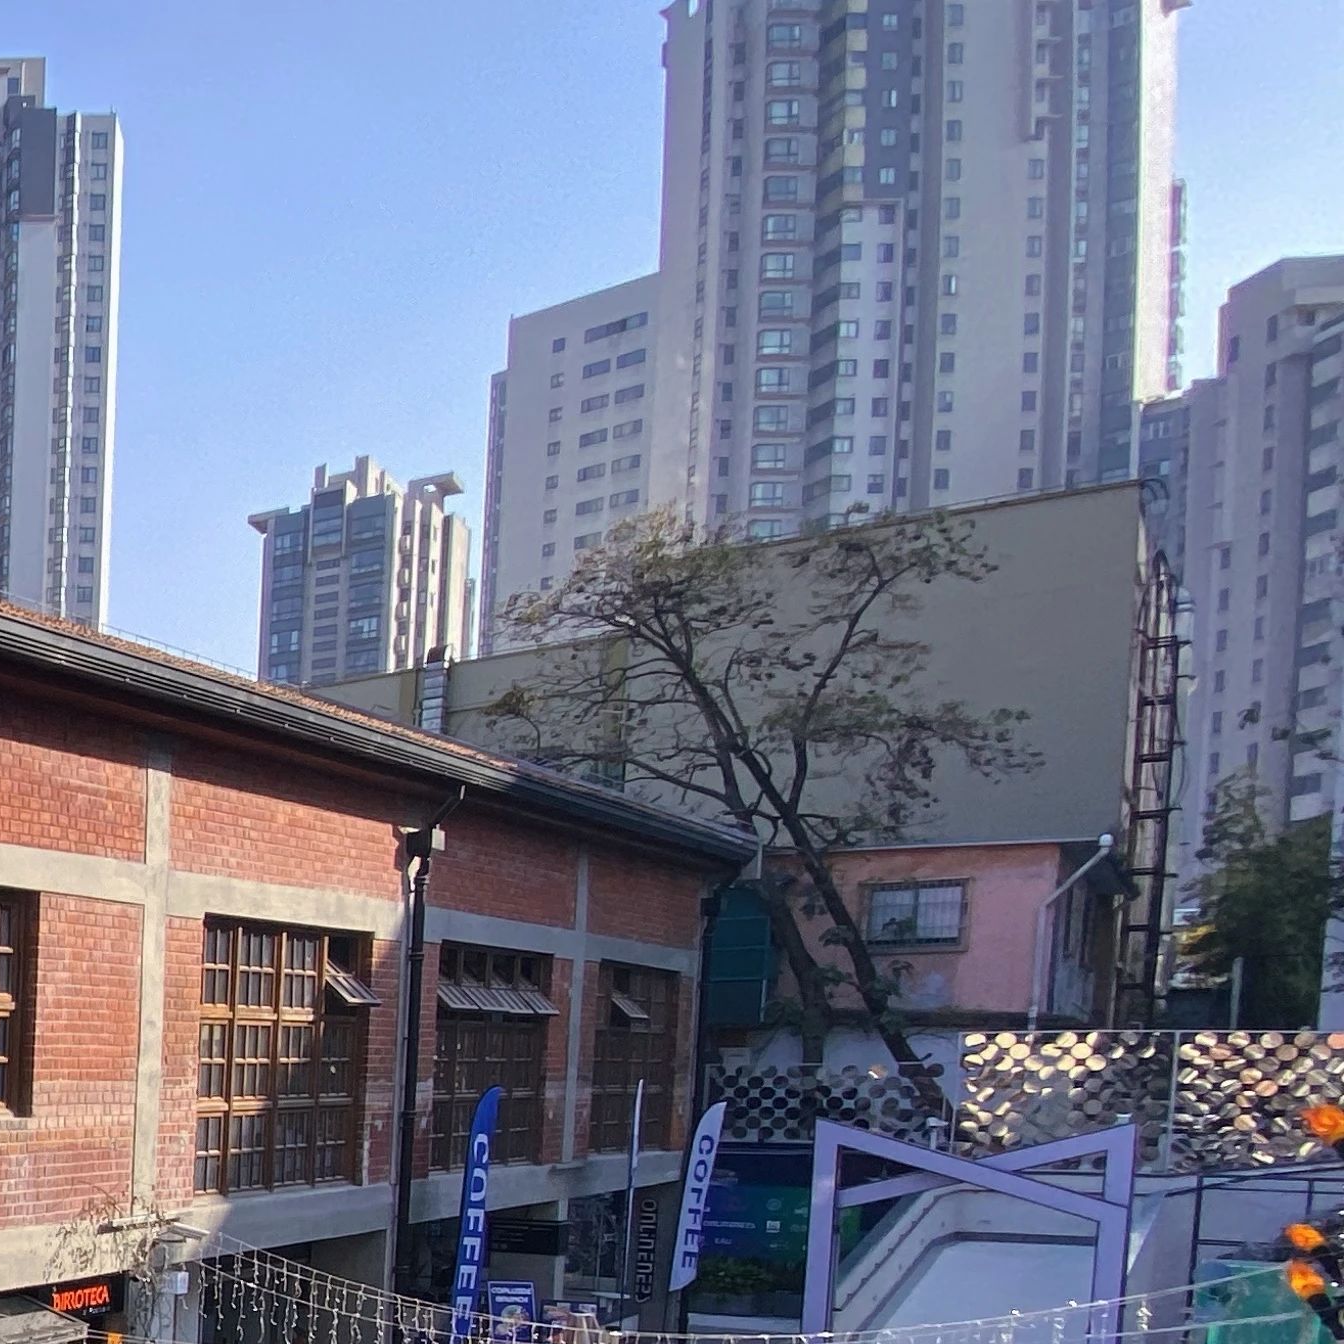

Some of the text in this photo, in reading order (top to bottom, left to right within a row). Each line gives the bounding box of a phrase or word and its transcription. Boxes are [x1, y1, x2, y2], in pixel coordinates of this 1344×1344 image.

[455, 1132, 490, 1321] COFFEE
[682, 1134, 715, 1270] COFFEE
[51, 1283, 111, 1311] BIRROTECA
